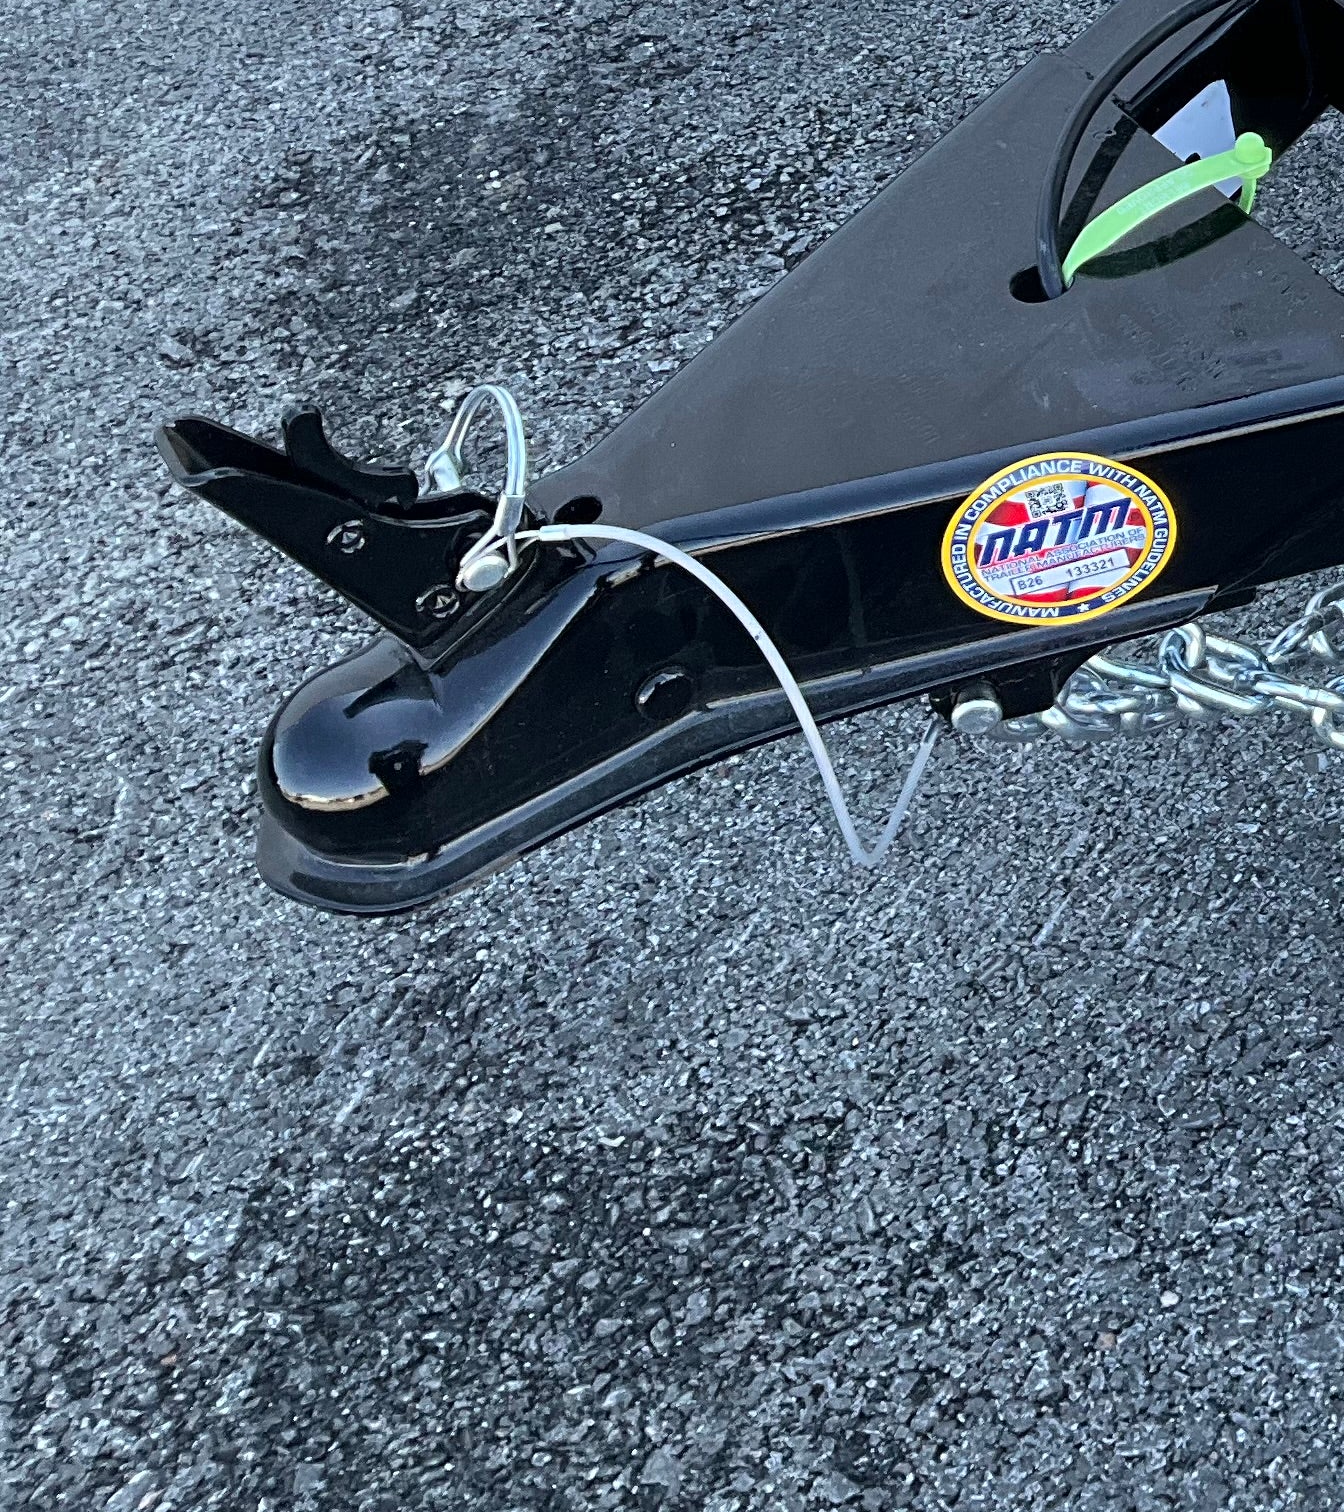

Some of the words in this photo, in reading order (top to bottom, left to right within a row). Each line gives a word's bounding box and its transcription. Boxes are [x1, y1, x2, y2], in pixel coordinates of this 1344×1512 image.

[964, 459, 1083, 523] COMPLIANCE
[1088, 463, 1133, 485] WITH
[1135, 487, 1168, 527] NATM
[955, 526, 969, 540] IN
[981, 556, 1041, 576] NATIONAL
[1047, 533, 1122, 558] ASSOCIATION
[1125, 528, 1143, 538] OF
[951, 544, 1060, 618] MANUFACTURED
[983, 564, 1034, 582] TRAILER
[1035, 534, 1145, 569] MANUFACTURERS
[1018, 576, 1043, 591] B26
[1065, 557, 1115, 579] 133321
[1102, 529, 1168, 603] GUIDELINES
